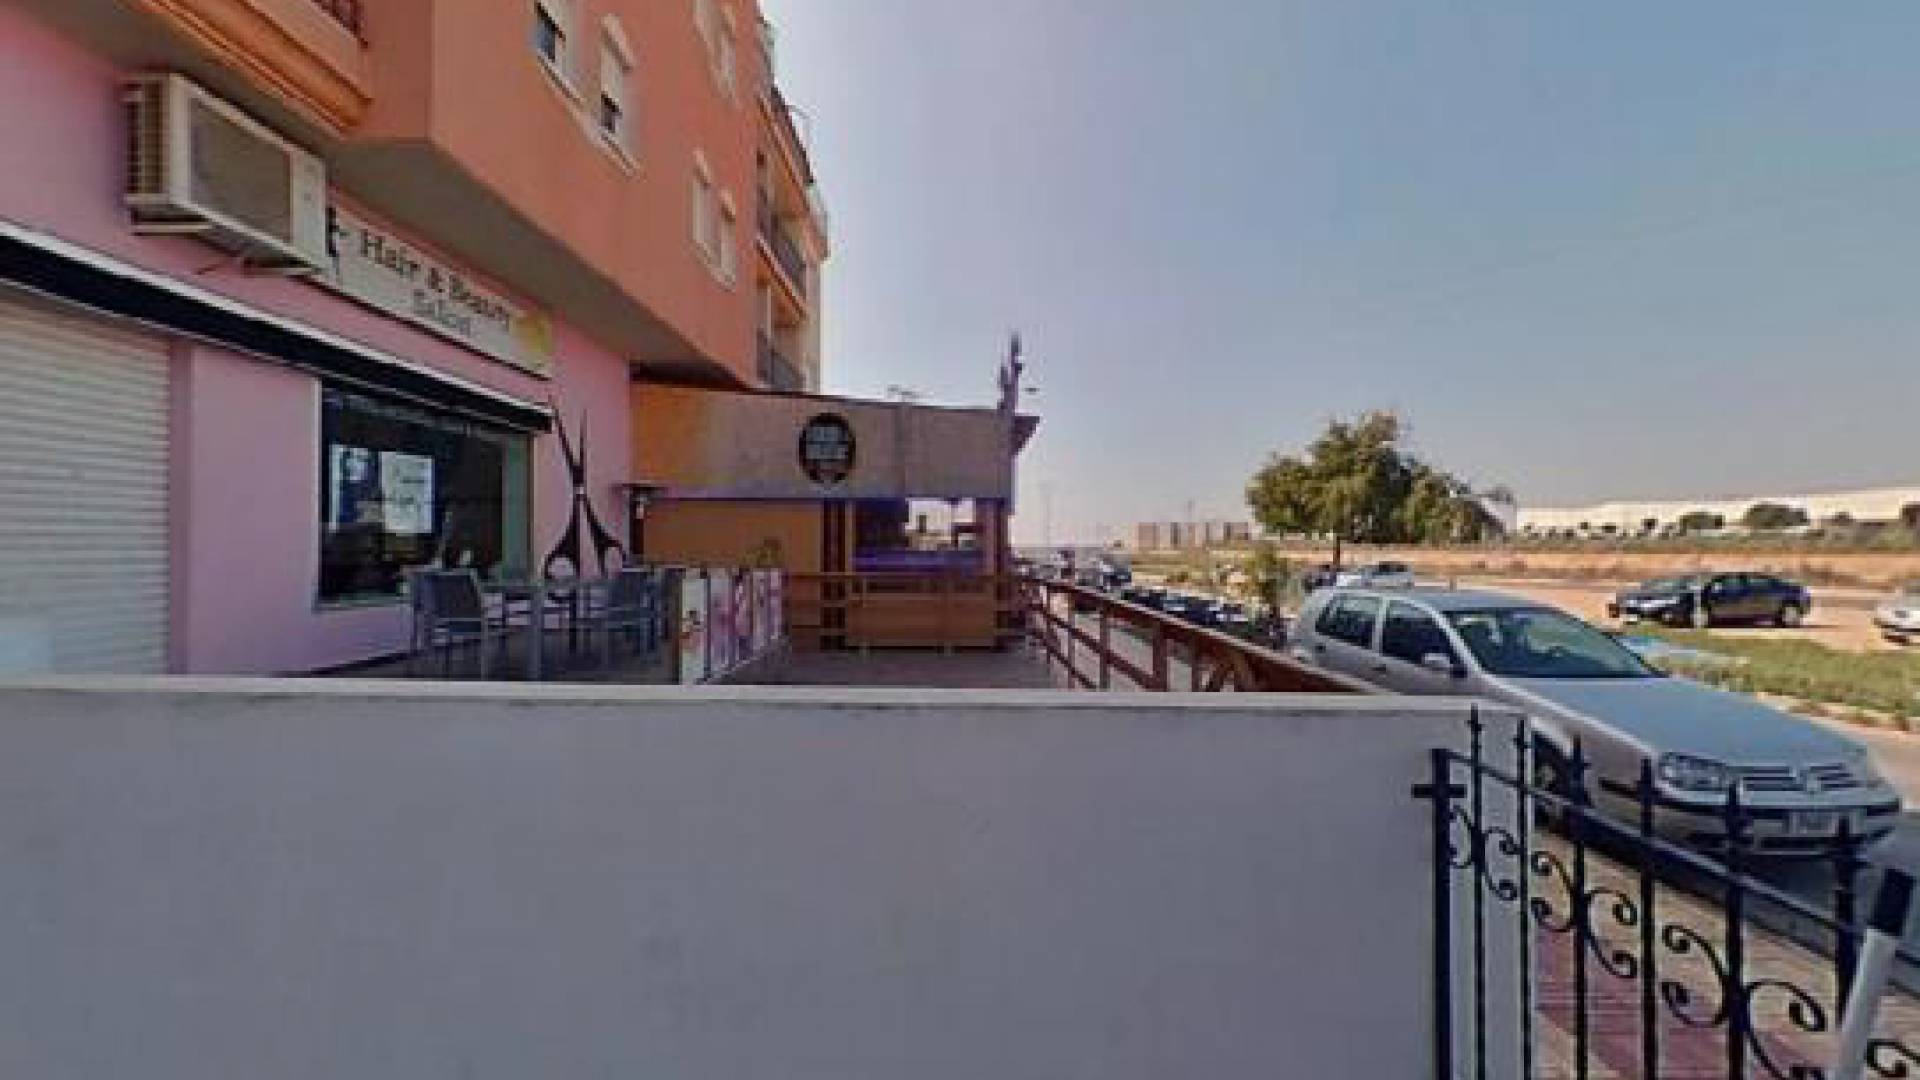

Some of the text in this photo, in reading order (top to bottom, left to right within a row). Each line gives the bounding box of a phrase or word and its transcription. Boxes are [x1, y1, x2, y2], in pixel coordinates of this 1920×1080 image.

[360, 227, 512, 333] Hair & Beauty
